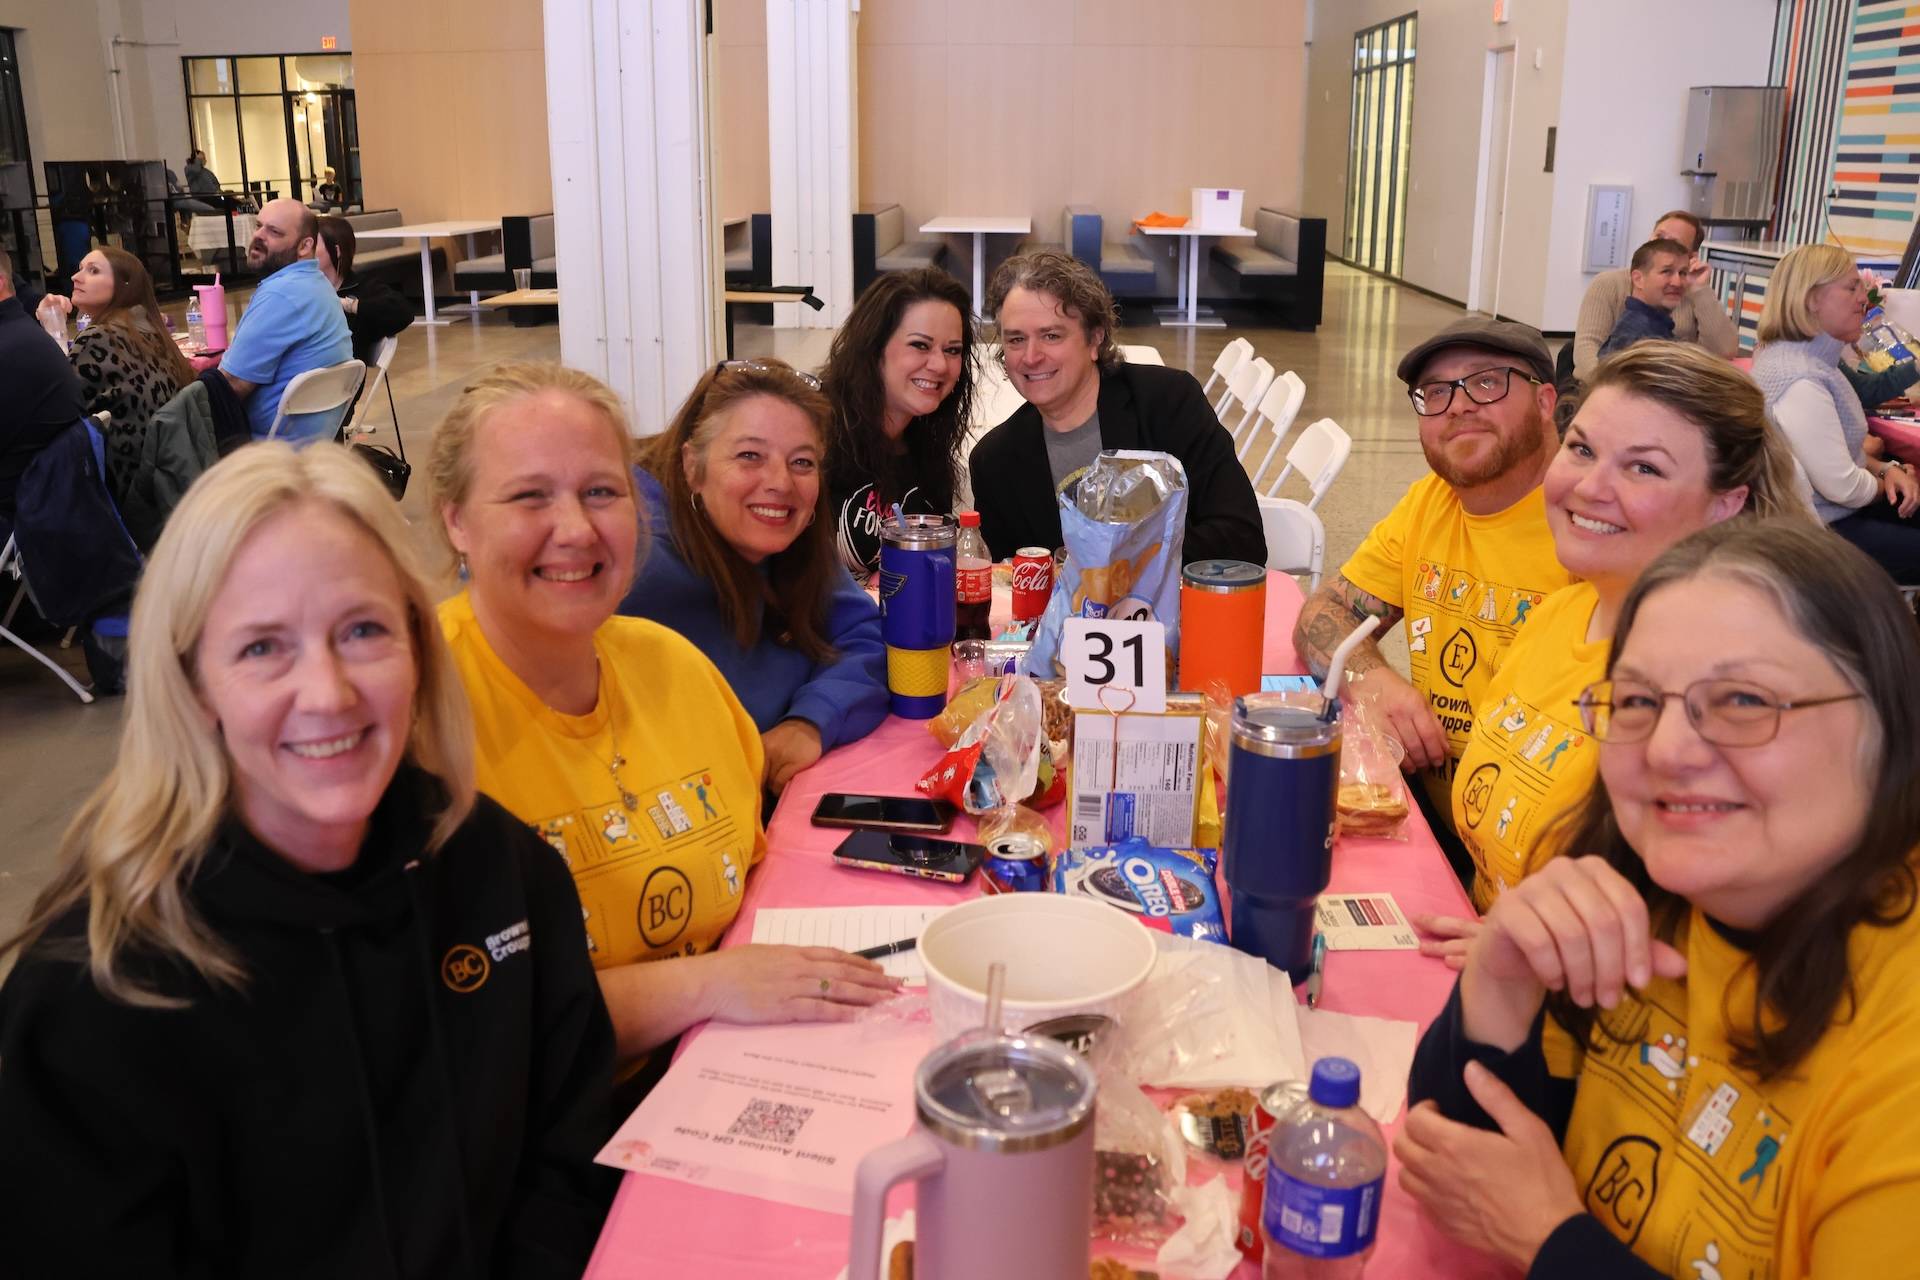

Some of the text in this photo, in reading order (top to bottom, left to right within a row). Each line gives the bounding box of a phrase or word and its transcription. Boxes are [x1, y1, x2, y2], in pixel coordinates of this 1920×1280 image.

[1012, 561, 1052, 591] Cola
[1084, 632, 1144, 688] 31
[1430, 688, 1468, 714] rown
[648, 885, 685, 931] BC
[1123, 857, 1170, 917] OREO
[450, 953, 483, 983] BC
[674, 1126, 836, 1165] Silent Auction QR Code
[1595, 1155, 1644, 1230] BC
